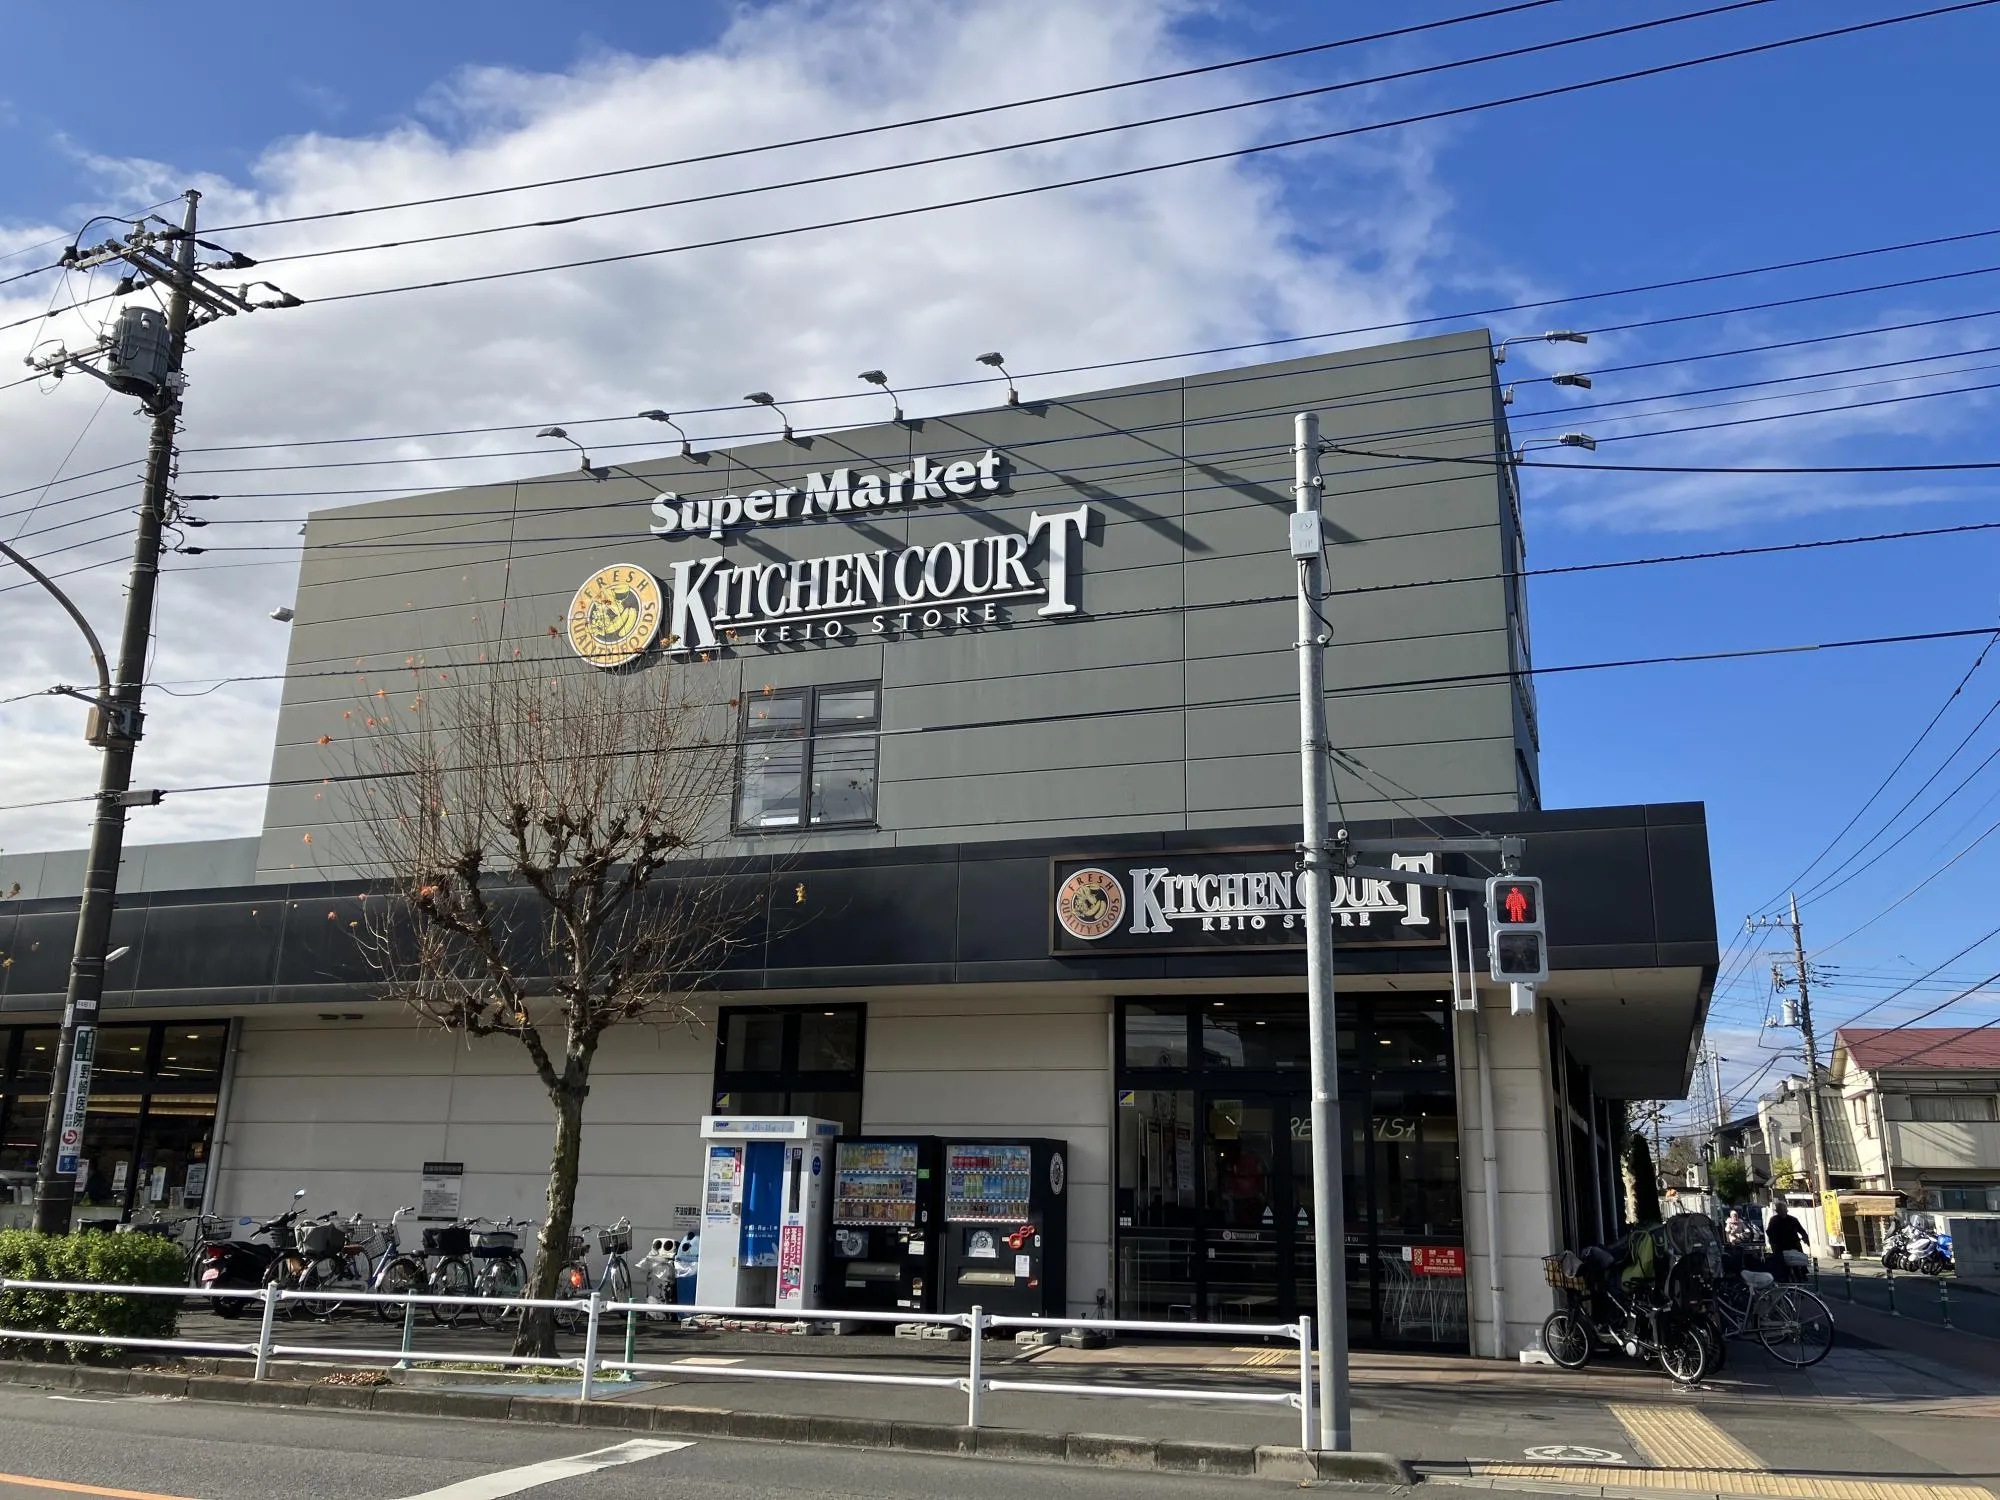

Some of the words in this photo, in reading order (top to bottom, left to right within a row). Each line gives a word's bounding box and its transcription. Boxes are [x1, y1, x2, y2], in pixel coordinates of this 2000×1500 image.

[650, 485, 800, 540] Super
[801, 449, 1001, 516] Market
[584, 571, 649, 598] FRESH
[664, 549, 886, 656] KITCHEN
[895, 504, 1088, 617] COURT
[754, 619, 844, 644] KEIO
[871, 602, 997, 634] STORE
[1068, 874, 1114, 891] FRESH
[1128, 867, 1293, 934] KITCHEN
[1061, 898, 1092, 934] QUALITY
[1096, 898, 1120, 932] FOODS
[1202, 916, 1265, 931] KEIO
